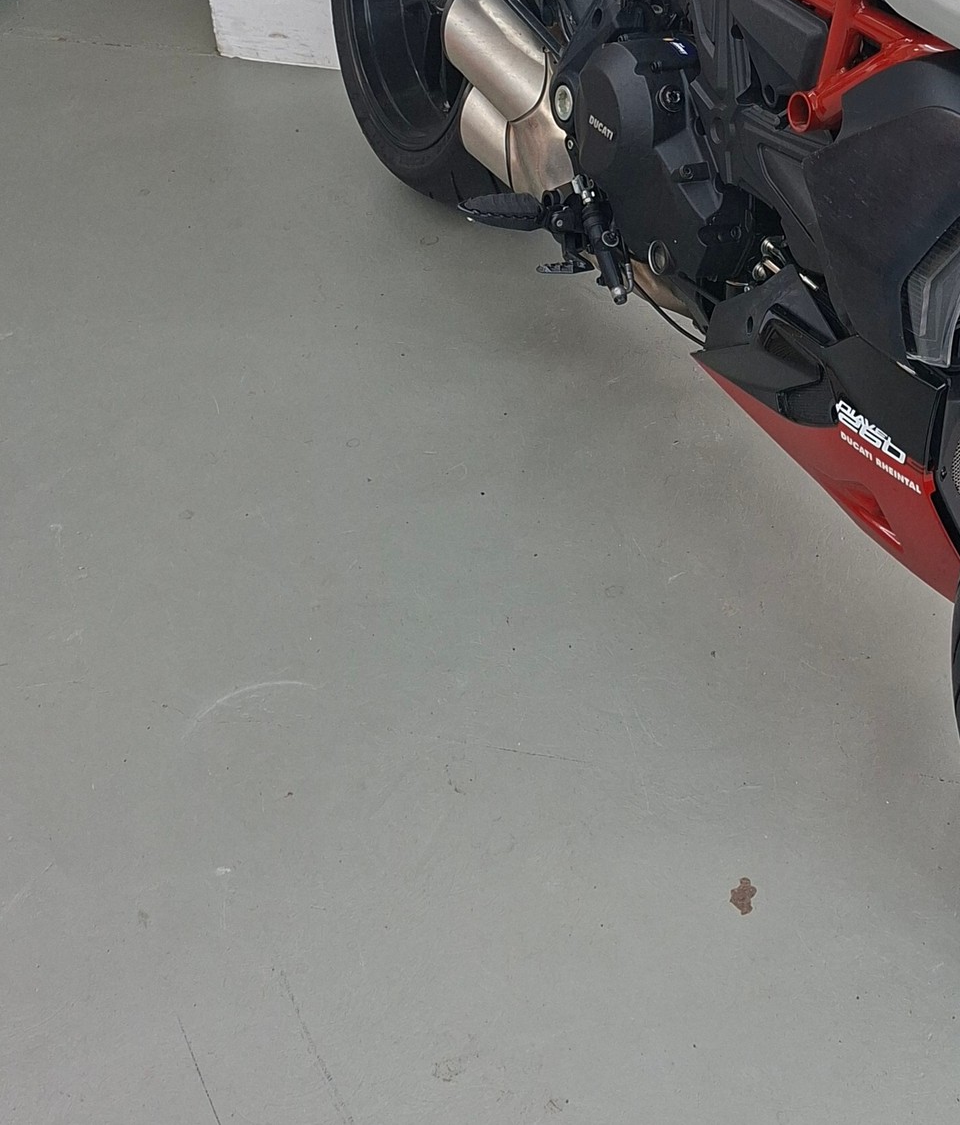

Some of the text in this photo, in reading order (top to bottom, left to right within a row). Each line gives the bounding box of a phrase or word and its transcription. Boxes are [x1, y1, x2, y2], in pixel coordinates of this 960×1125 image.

[588, 114, 614, 141] DUCATI
[840, 430, 922, 495] DUCATI RHEINTAL
